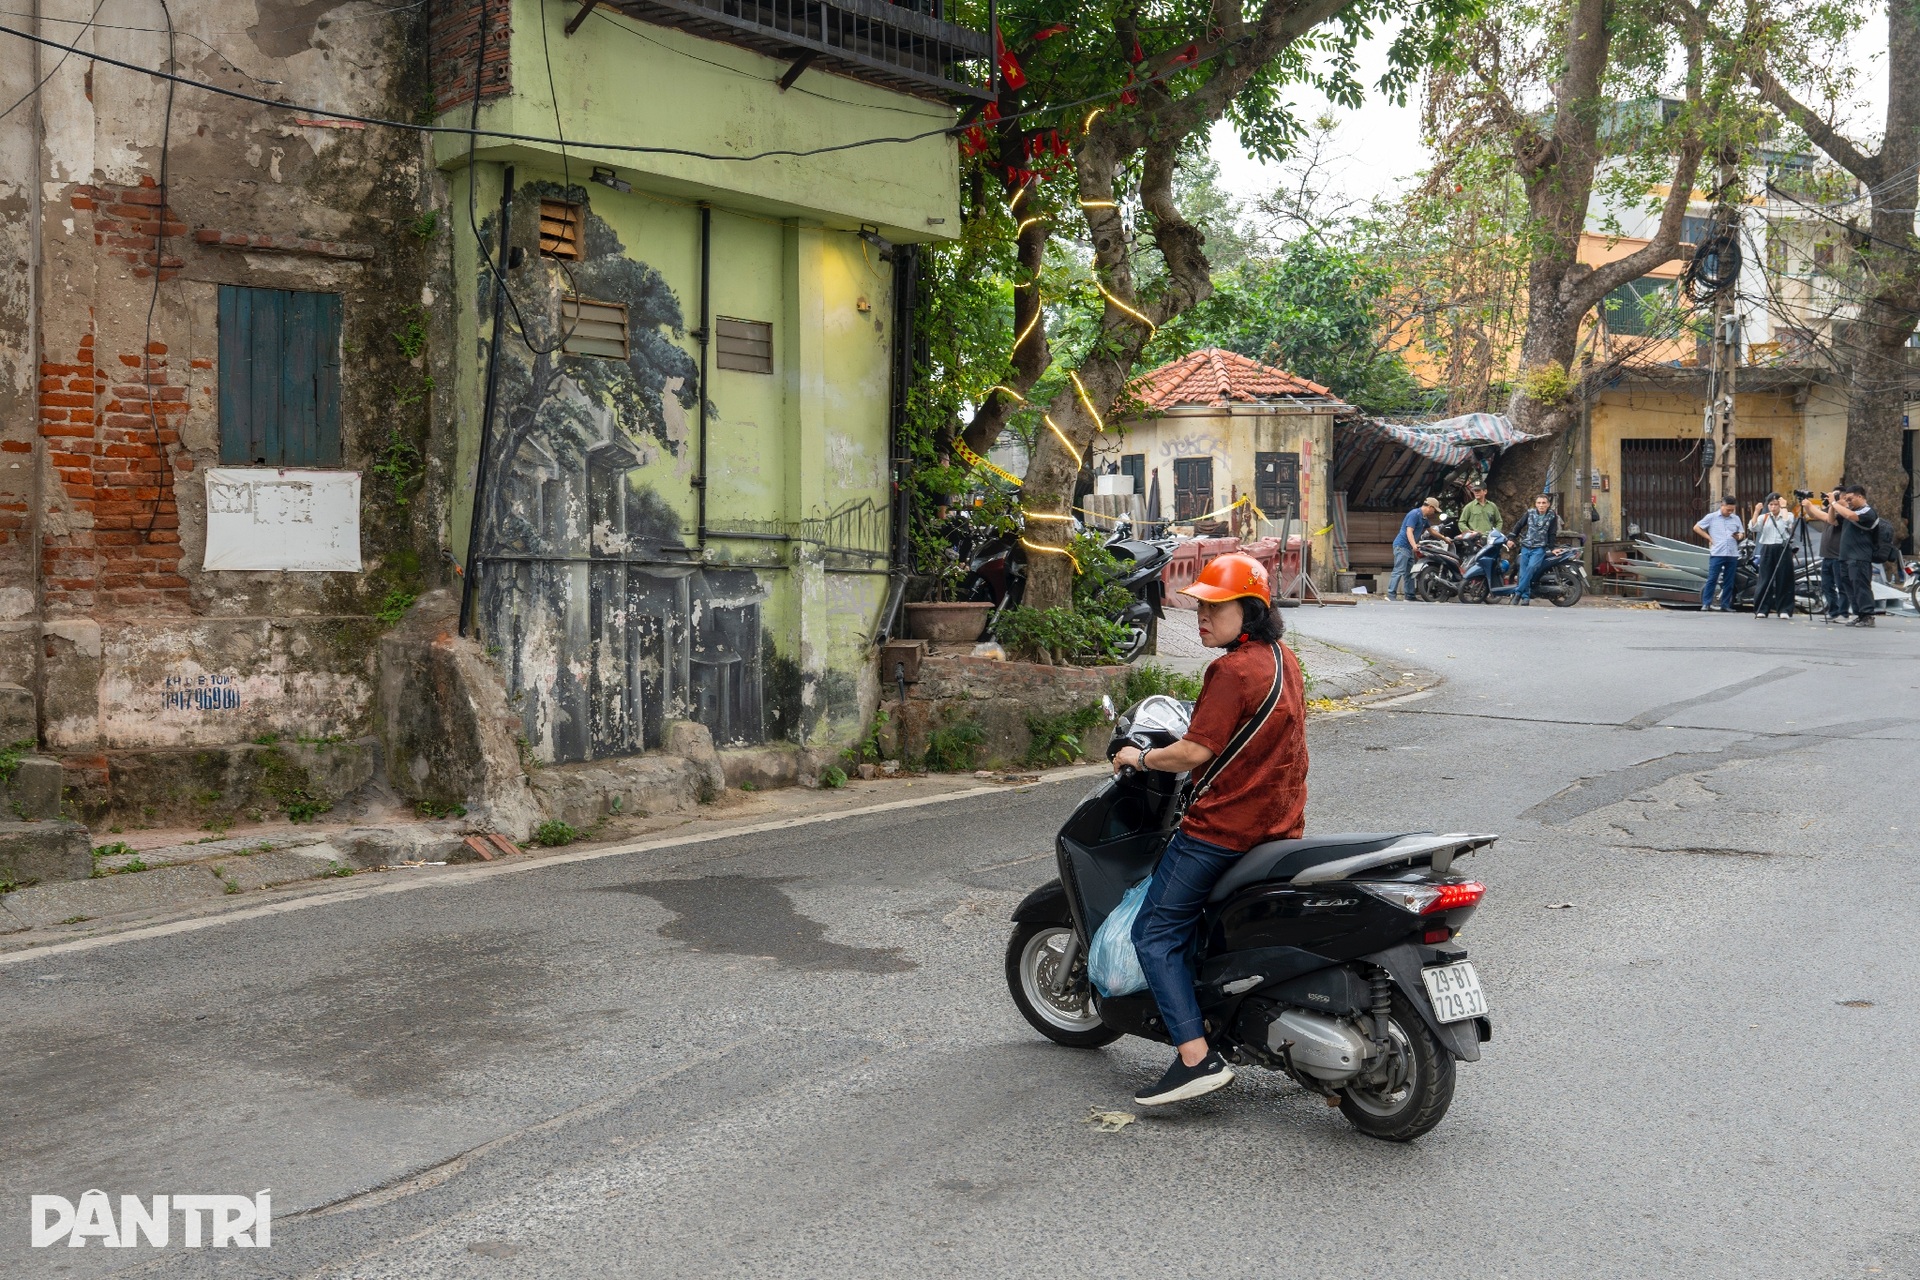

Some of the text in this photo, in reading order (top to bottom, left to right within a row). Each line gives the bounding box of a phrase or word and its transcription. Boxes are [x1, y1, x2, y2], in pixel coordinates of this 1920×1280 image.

[1303, 899, 1360, 907] LEAD
[1431, 966, 1472, 993] 29-B1
[1435, 989, 1482, 1019] 729.37
